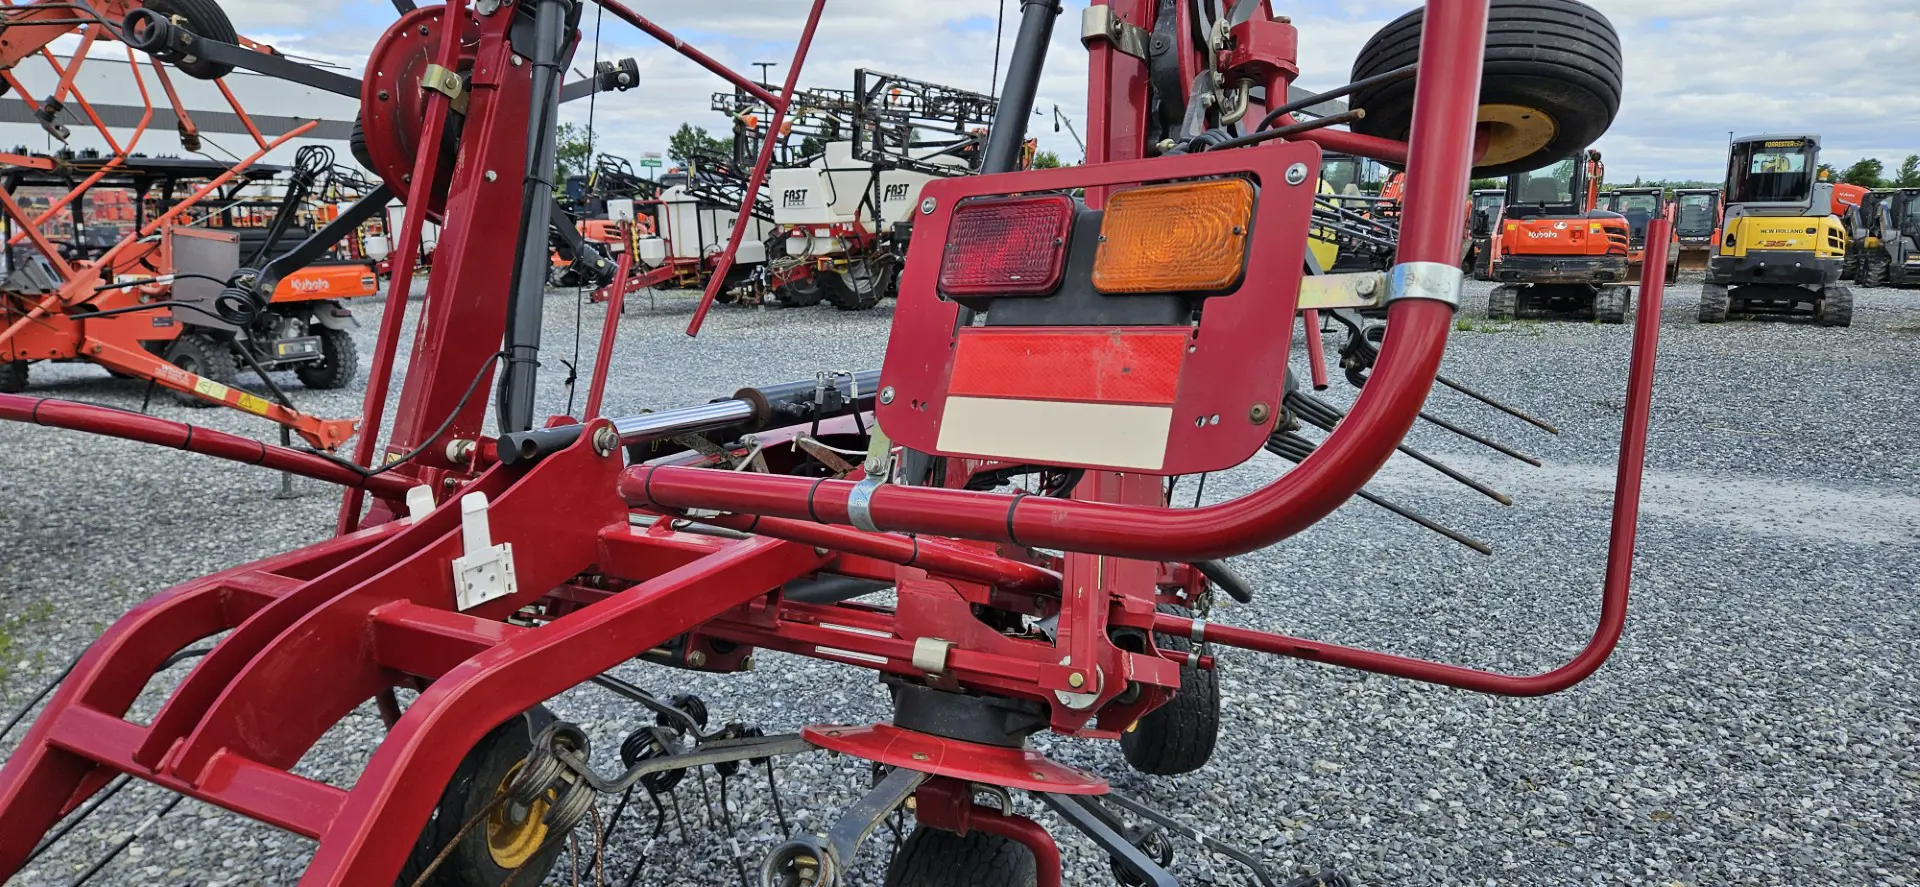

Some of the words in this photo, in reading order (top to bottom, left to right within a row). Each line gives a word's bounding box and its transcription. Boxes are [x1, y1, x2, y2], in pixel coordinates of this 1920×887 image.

[783, 188, 808, 208] FAST
[883, 183, 910, 203] FAST
[1528, 230, 1557, 238] Kubota
[291, 278, 329, 290] Kubota
